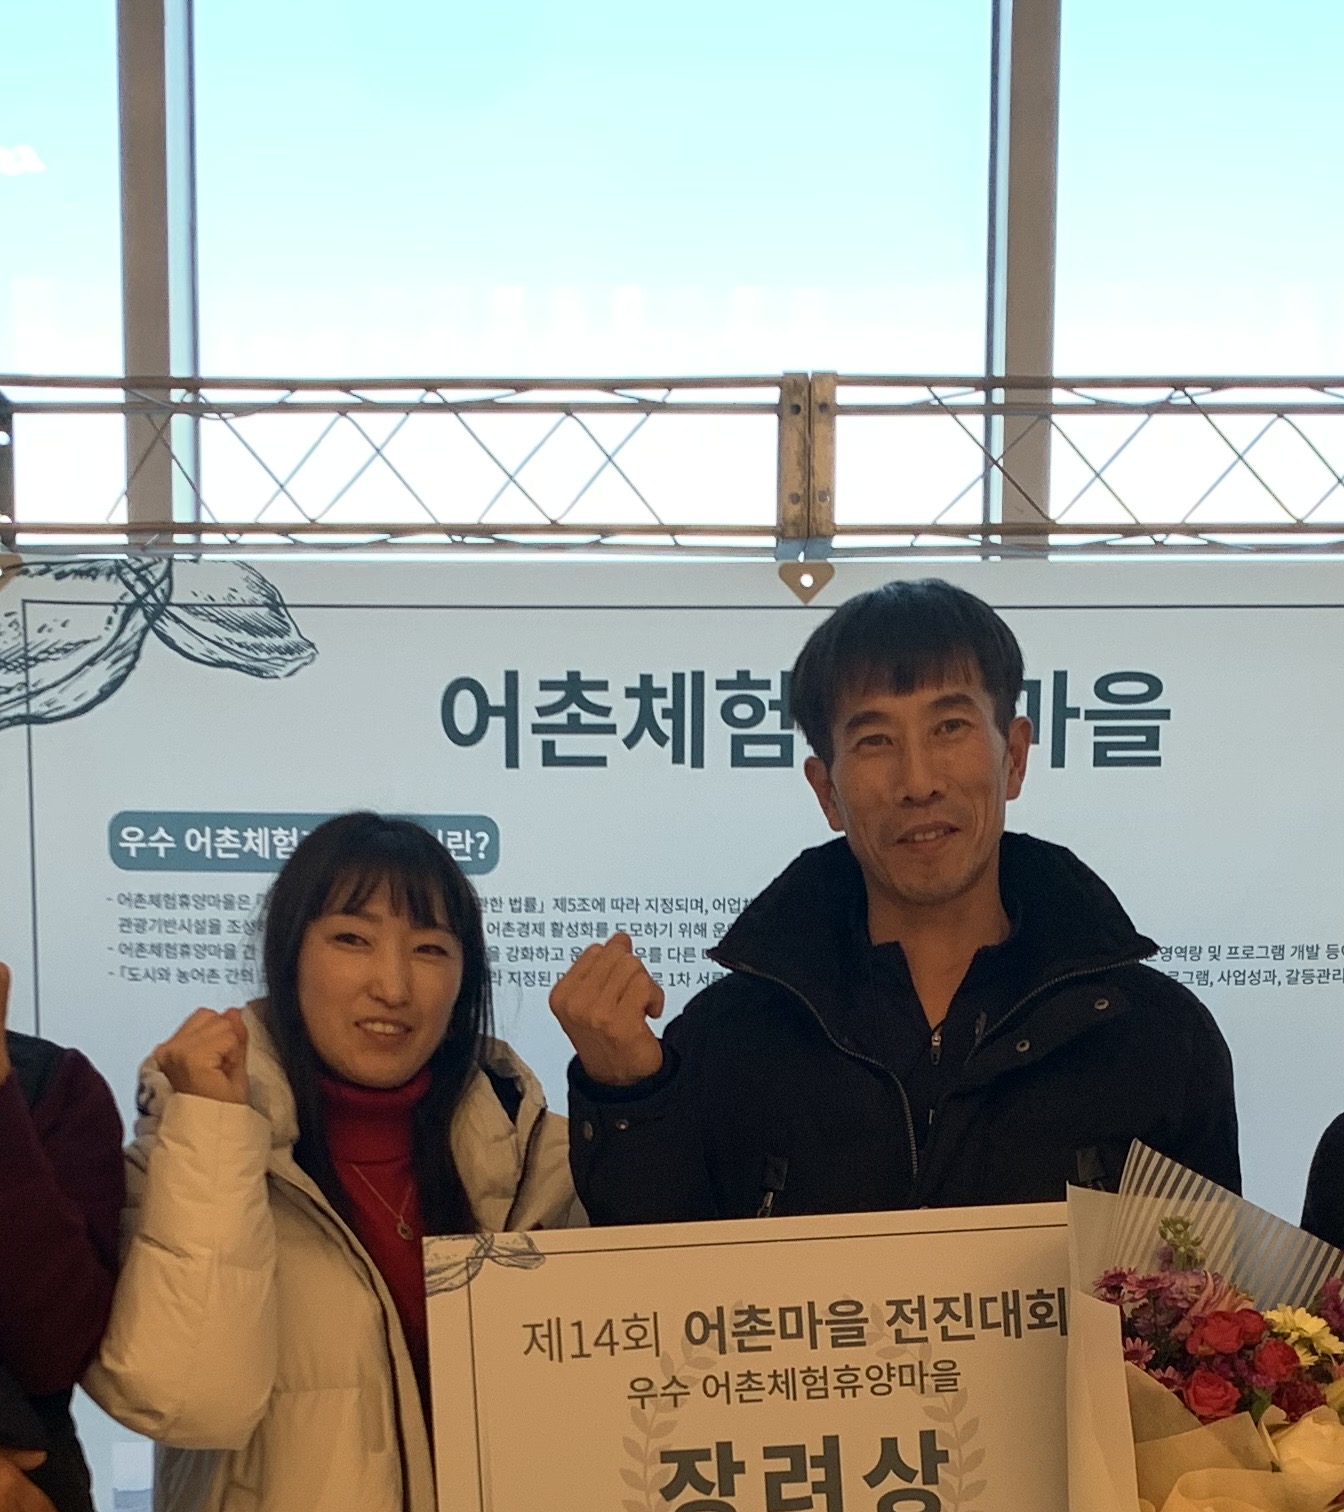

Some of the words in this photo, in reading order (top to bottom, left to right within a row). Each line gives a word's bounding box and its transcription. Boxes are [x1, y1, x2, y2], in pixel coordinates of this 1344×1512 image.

[441, 670, 1171, 768] 어촌체험마을
[119, 826, 176, 858] 우수
[509, 897, 544, 914] 법률」
[553, 897, 606, 913] 제5조에
[611, 897, 640, 913] 따라
[645, 897, 708, 914] 지정되며,
[486, 922, 545, 939] 어촌경제
[551, 922, 609, 938] 활성화를
[615, 922, 672, 938] 도모하기
[679, 922, 707, 938] 위해
[506, 947, 565, 963] 강화하고
[667, 947, 696, 963] 다른
[1147, 946, 1203, 963] 영역량
[1208, 945, 1221, 961] 및
[1227, 945, 1285, 960] 프로그램
[1291, 944, 1320, 960] 개발
[508, 971, 551, 987] 지정된
[669, 972, 691, 987] 1차
[1218, 969, 1281, 986] 사업성과,
[523, 1312, 660, 1363] 제14회
[684, 1299, 870, 1357] 어촌마을
[883, 1287, 1069, 1346] 전진대회
[627, 1375, 690, 1410] 우수
[701, 1359, 962, 1407] 어촌체험휴양마을
